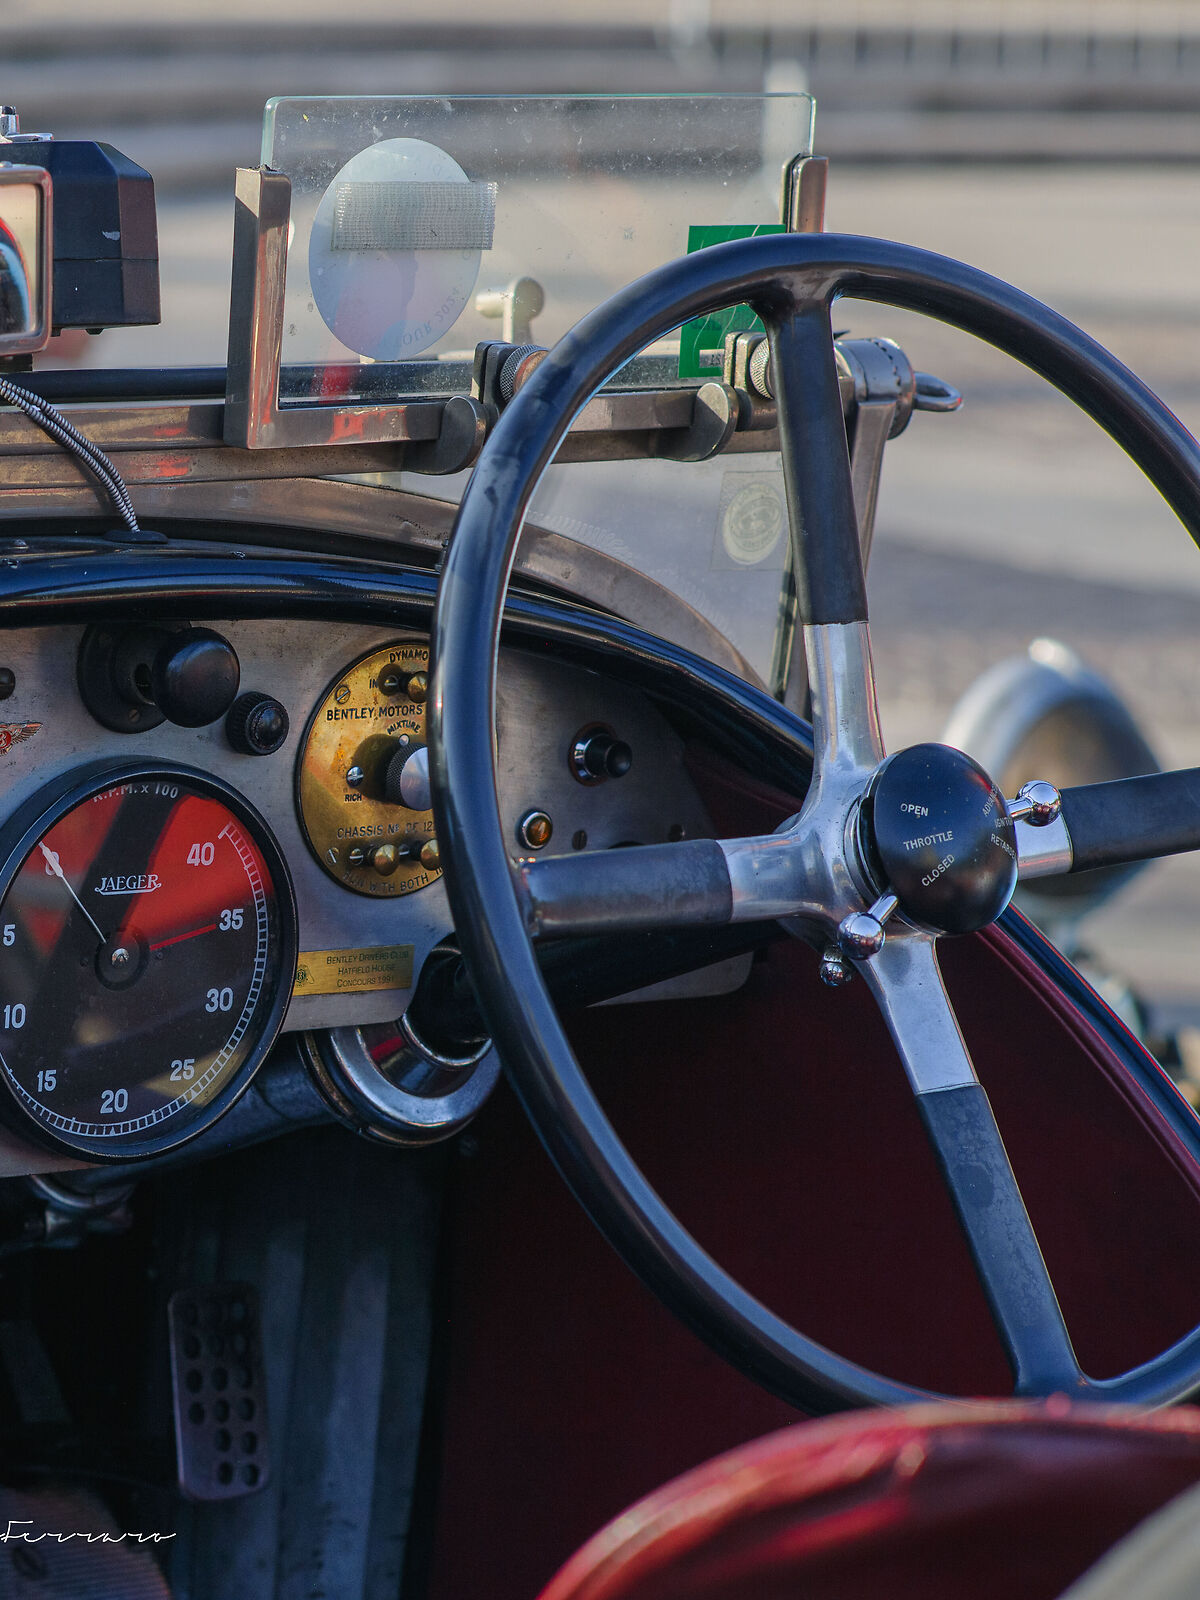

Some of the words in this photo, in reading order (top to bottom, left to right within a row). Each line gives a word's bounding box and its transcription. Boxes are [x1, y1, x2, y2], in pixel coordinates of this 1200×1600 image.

[389, 648, 429, 663] DYNAMO
[326, 706, 375, 721] BENTLEY
[378, 704, 423, 718] MOTORS
[387, 720, 420, 735] MIXTURE
[155, 783, 178, 799] 100
[344, 793, 362, 802] RICH
[900, 803, 929, 817] OPEN
[337, 825, 383, 840] CHASSIS
[903, 831, 954, 851] THROTTLE
[187, 842, 215, 867] 40
[921, 854, 955, 887] CLOSED
[94, 874, 161, 895] JAEGER
[400, 871, 429, 891] BOTH
[219, 909, 244, 931] 35
[3, 924, 16, 947] 5
[327, 955, 358, 965] BENTLEY
[359, 952, 389, 961] DRIVERS
[338, 966, 370, 976] HATFIELD
[337, 977, 376, 988] CONCOURS
[205, 988, 233, 1013] 30
[4, 1004, 26, 1029] 10
[170, 1059, 195, 1081] 25
[37, 1070, 57, 1092] 15
[100, 1089, 128, 1114] 20
